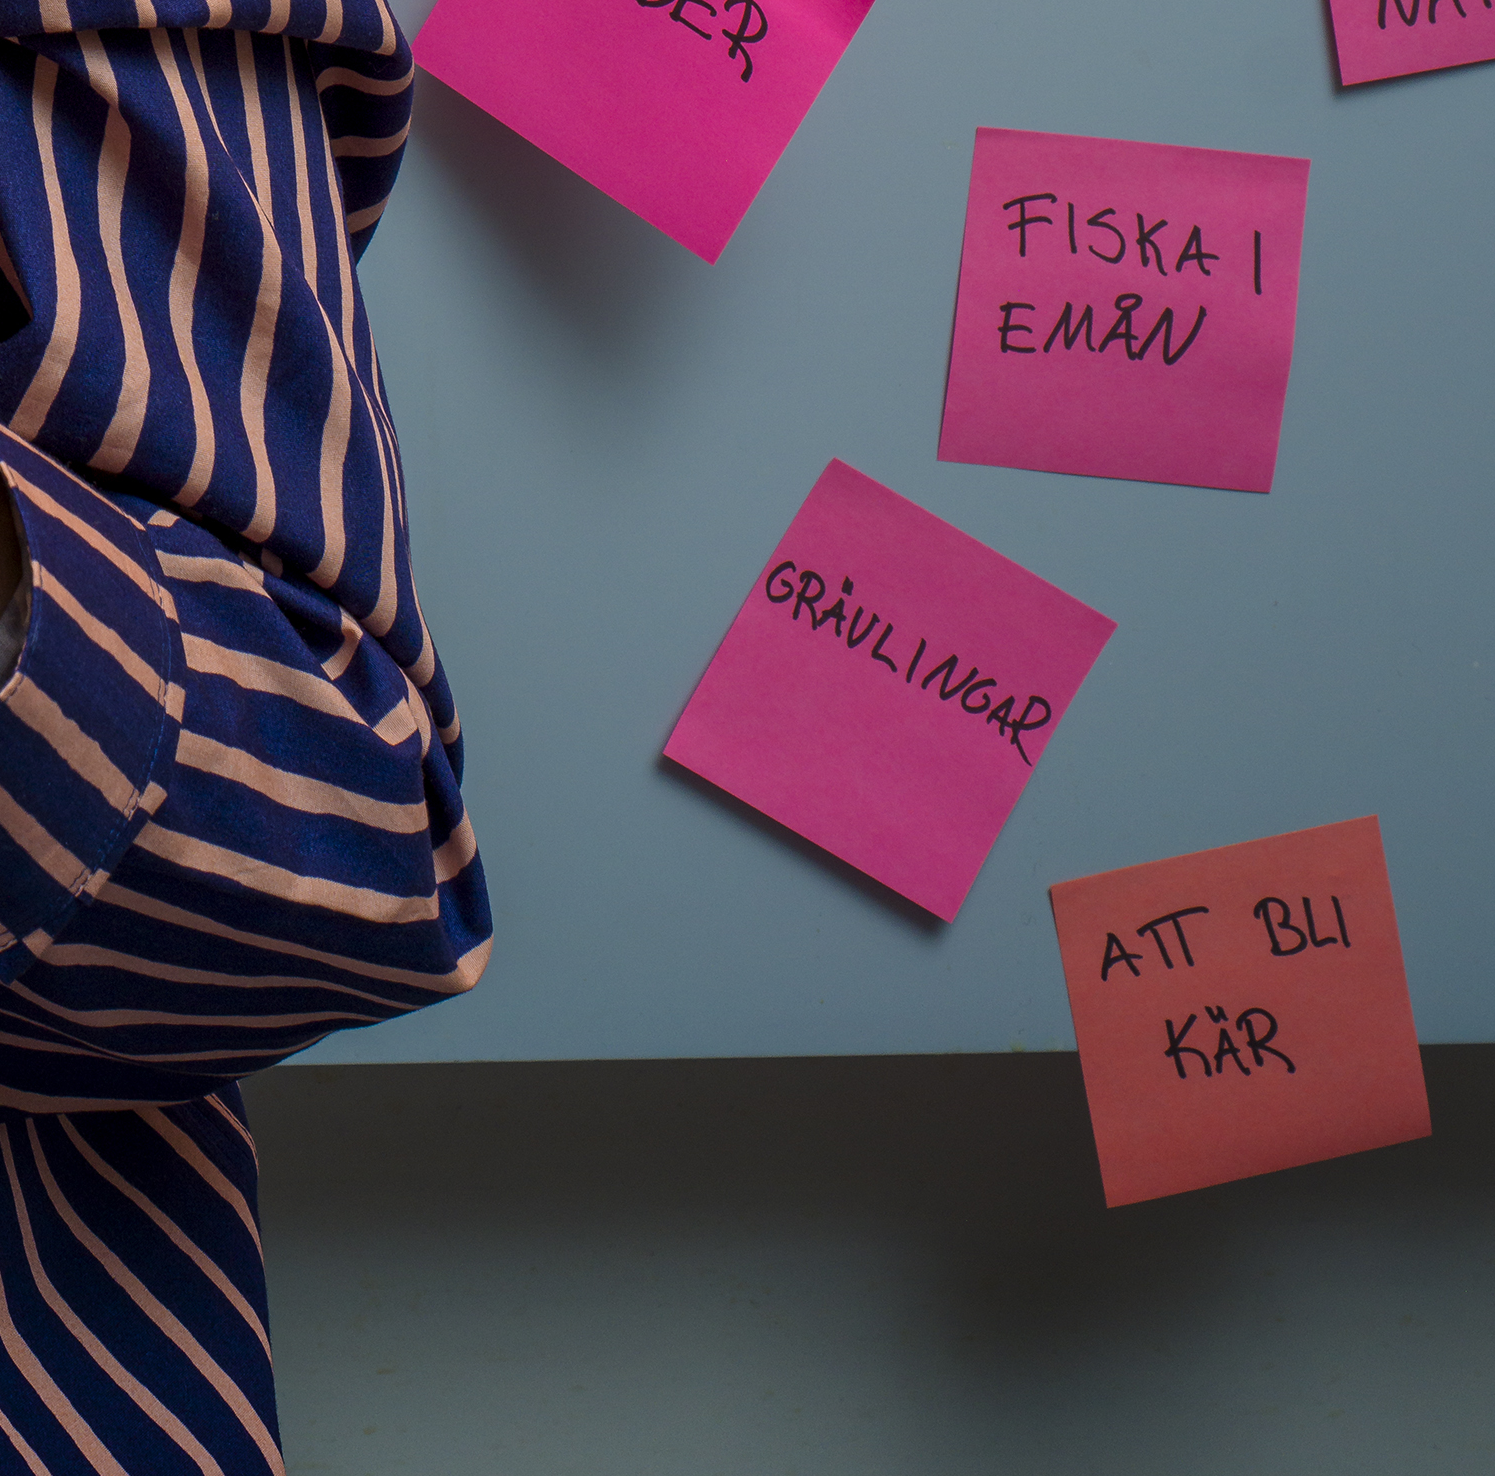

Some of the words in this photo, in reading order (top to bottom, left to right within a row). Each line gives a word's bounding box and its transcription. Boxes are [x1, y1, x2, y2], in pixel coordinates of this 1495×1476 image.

[1003, 193, 1220, 276] FISKA
[1251, 229, 1264, 297] I
[998, 293, 1207, 366] EMÅN
[766, 561, 1052, 766] GRÄVLINGAR
[1101, 906, 1209, 982] ATT
[1253, 896, 1351, 956] BLI
[1164, 1006, 1296, 1079] KÄR
